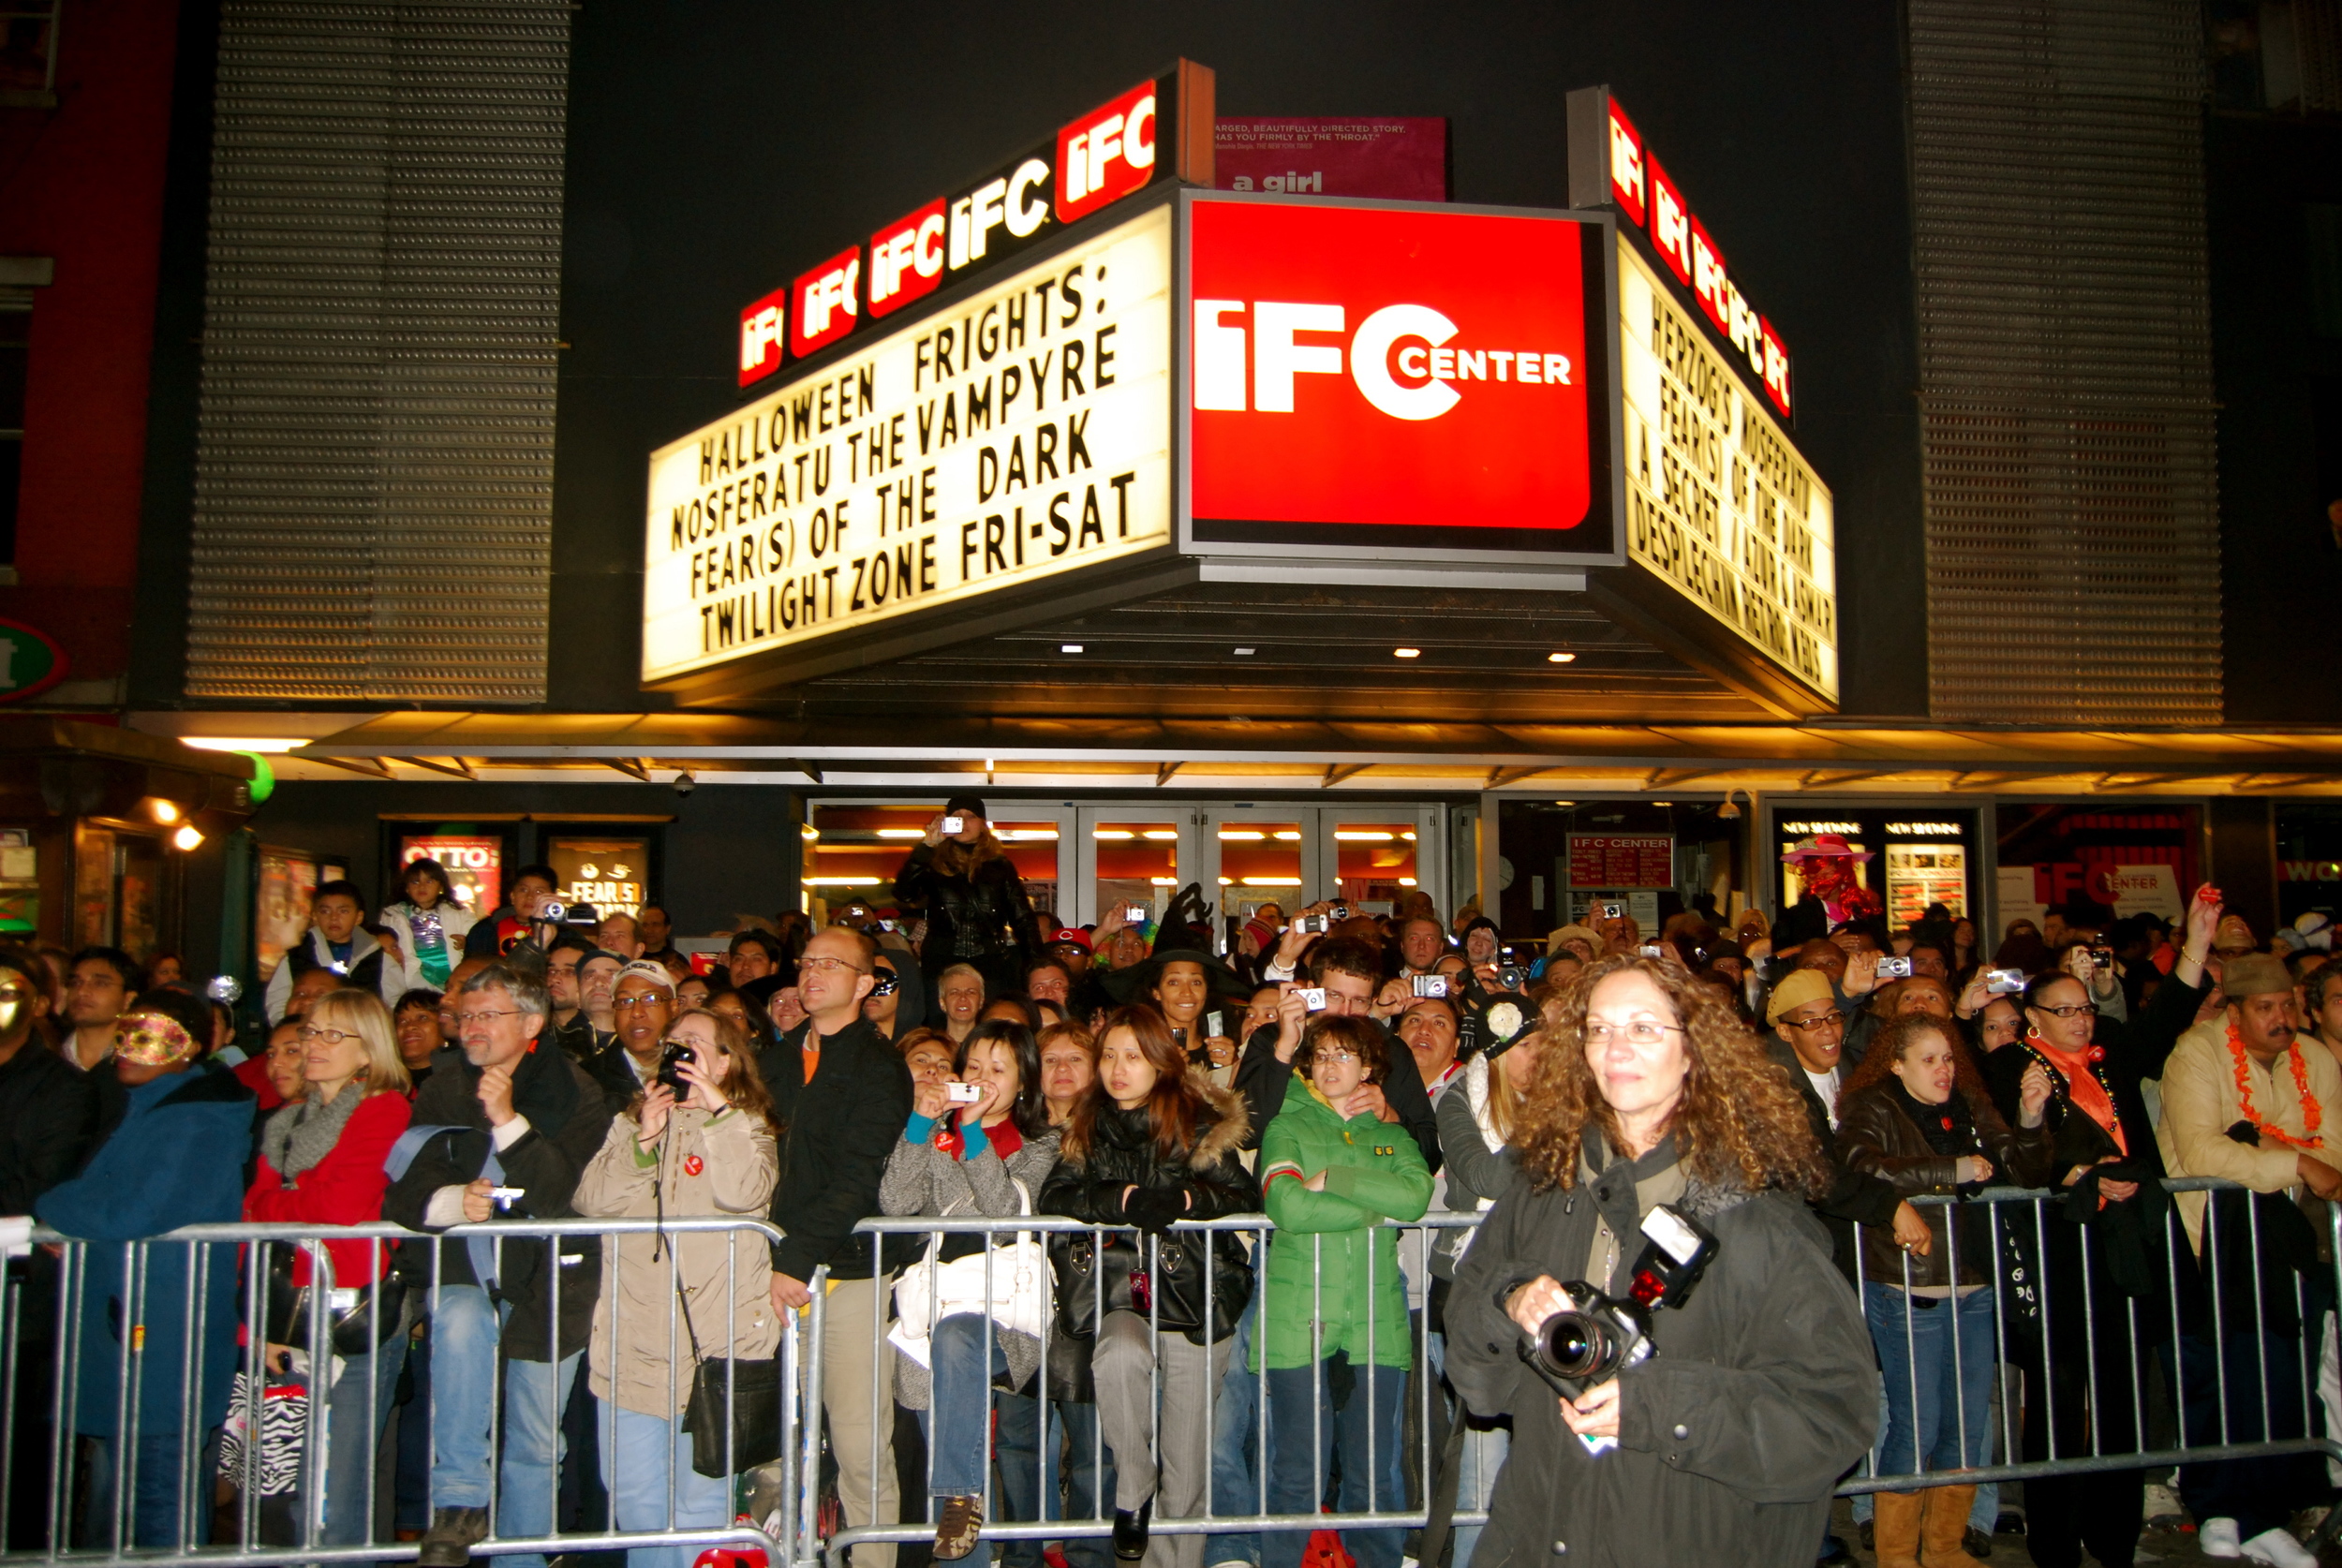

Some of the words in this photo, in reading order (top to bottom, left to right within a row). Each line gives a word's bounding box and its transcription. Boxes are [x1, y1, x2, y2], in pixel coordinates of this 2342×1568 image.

[1236, 133, 1256, 141] YOU
[1259, 133, 1294, 141] FIRMLY
[1297, 133, 1311, 141] BY
[1312, 133, 1332, 141] THE
[1253, 125, 1318, 133] BEAUTIFULLY
[1321, 125, 1370, 133] DIRECTED
[1233, 174, 1253, 191] a
[1263, 171, 1322, 194] girl
[699, 362, 875, 486] HALLOWEEN
[914, 264, 1106, 392] FRIGHTS:
[1398, 346, 1572, 386] CENTER
[671, 445, 832, 551] NOSFERATU
[848, 413, 905, 483] THE
[917, 324, 1117, 456] VAMPYRE
[691, 518, 795, 598] FEAR(S)
[810, 500, 848, 558] OF
[877, 466, 936, 544] THE
[979, 407, 1092, 504] DARK
[1639, 421, 1651, 488] A
[1661, 444, 1720, 550] SECRET
[1731, 451, 1749, 518] OF
[701, 566, 840, 652] TWILIGHT
[850, 535, 936, 612] ZONE
[961, 471, 1135, 581] FRI-SAT
[1610, 839, 1668, 848] CENTER
